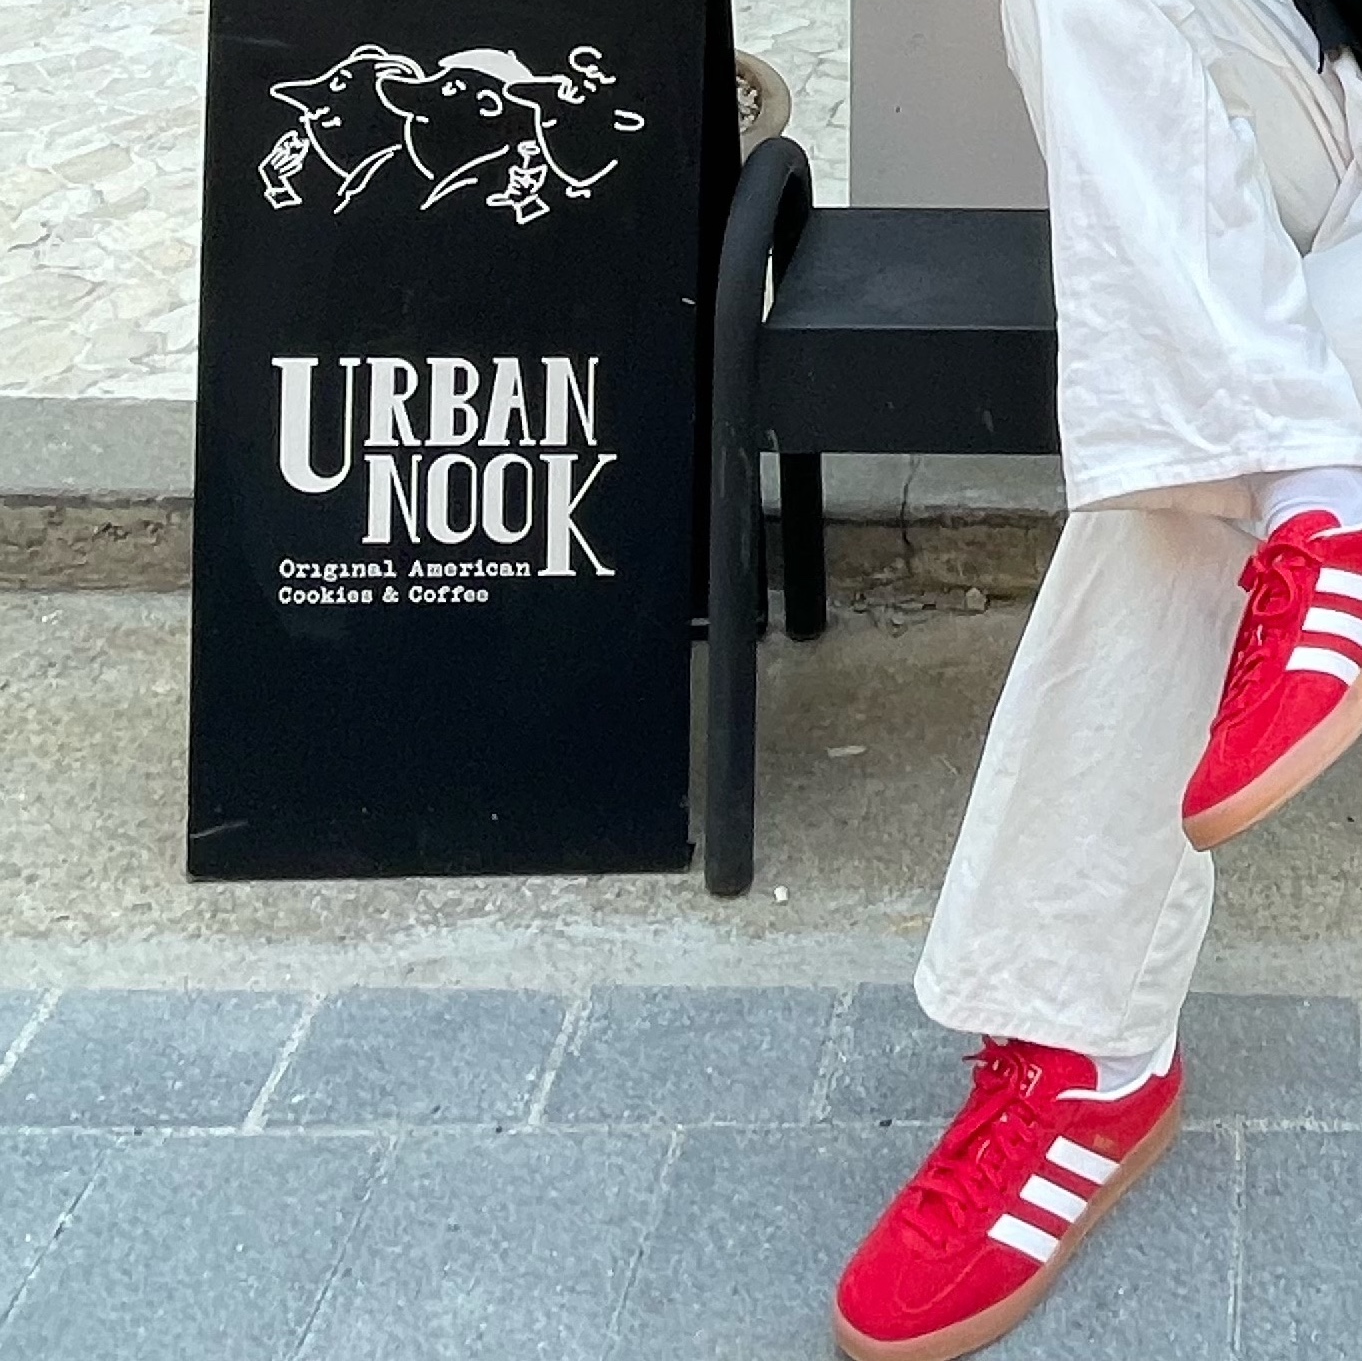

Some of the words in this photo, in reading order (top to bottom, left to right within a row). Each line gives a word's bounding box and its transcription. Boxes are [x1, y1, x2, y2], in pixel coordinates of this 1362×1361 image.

[271, 357, 599, 493] URBAN
[362, 453, 617, 576] NOOK
[278, 586, 373, 604] Cookies
[382, 586, 399, 604] &
[408, 586, 489, 604] Coffee
[279, 559, 397, 582] Original
[408, 559, 531, 577] American
